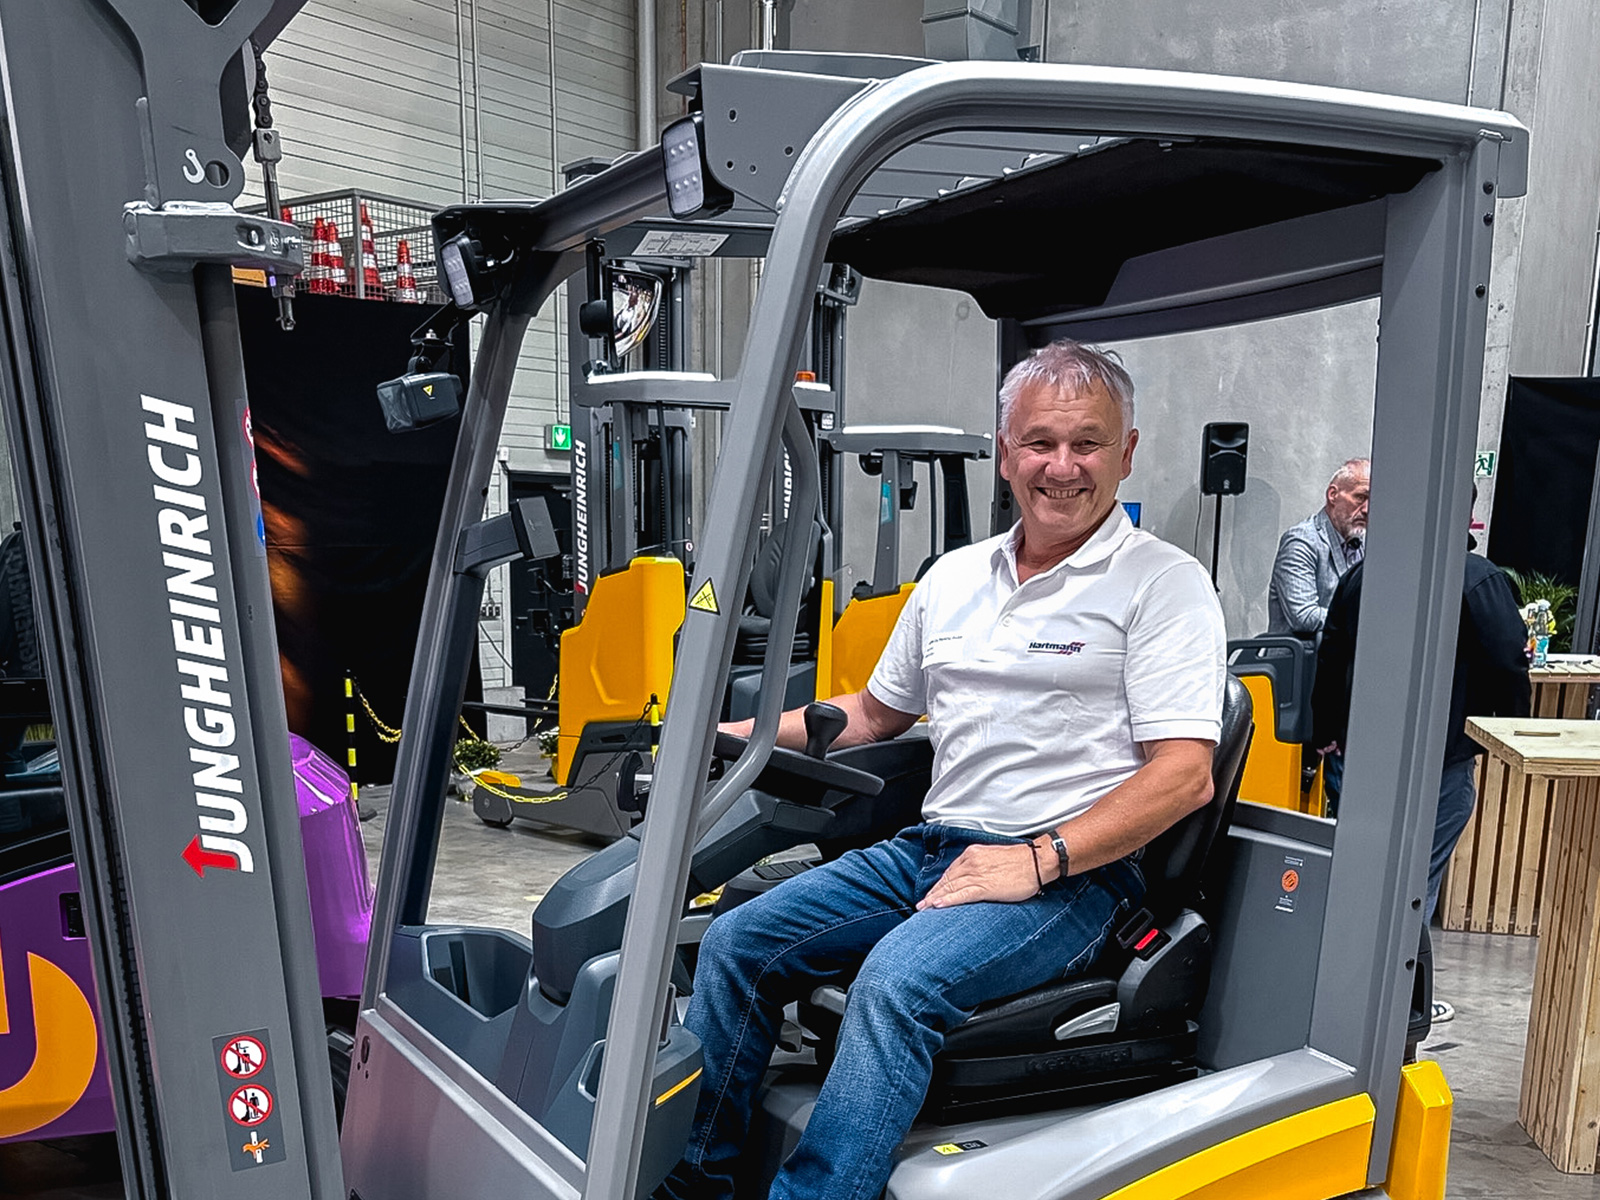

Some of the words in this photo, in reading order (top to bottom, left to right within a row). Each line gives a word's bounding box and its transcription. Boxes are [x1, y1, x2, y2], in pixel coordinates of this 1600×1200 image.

[574, 440, 588, 595] JUNGHEINRICH
[140, 394, 254, 874] JUNGHEINRICH
[1028, 642, 1081, 653] Hartmann
